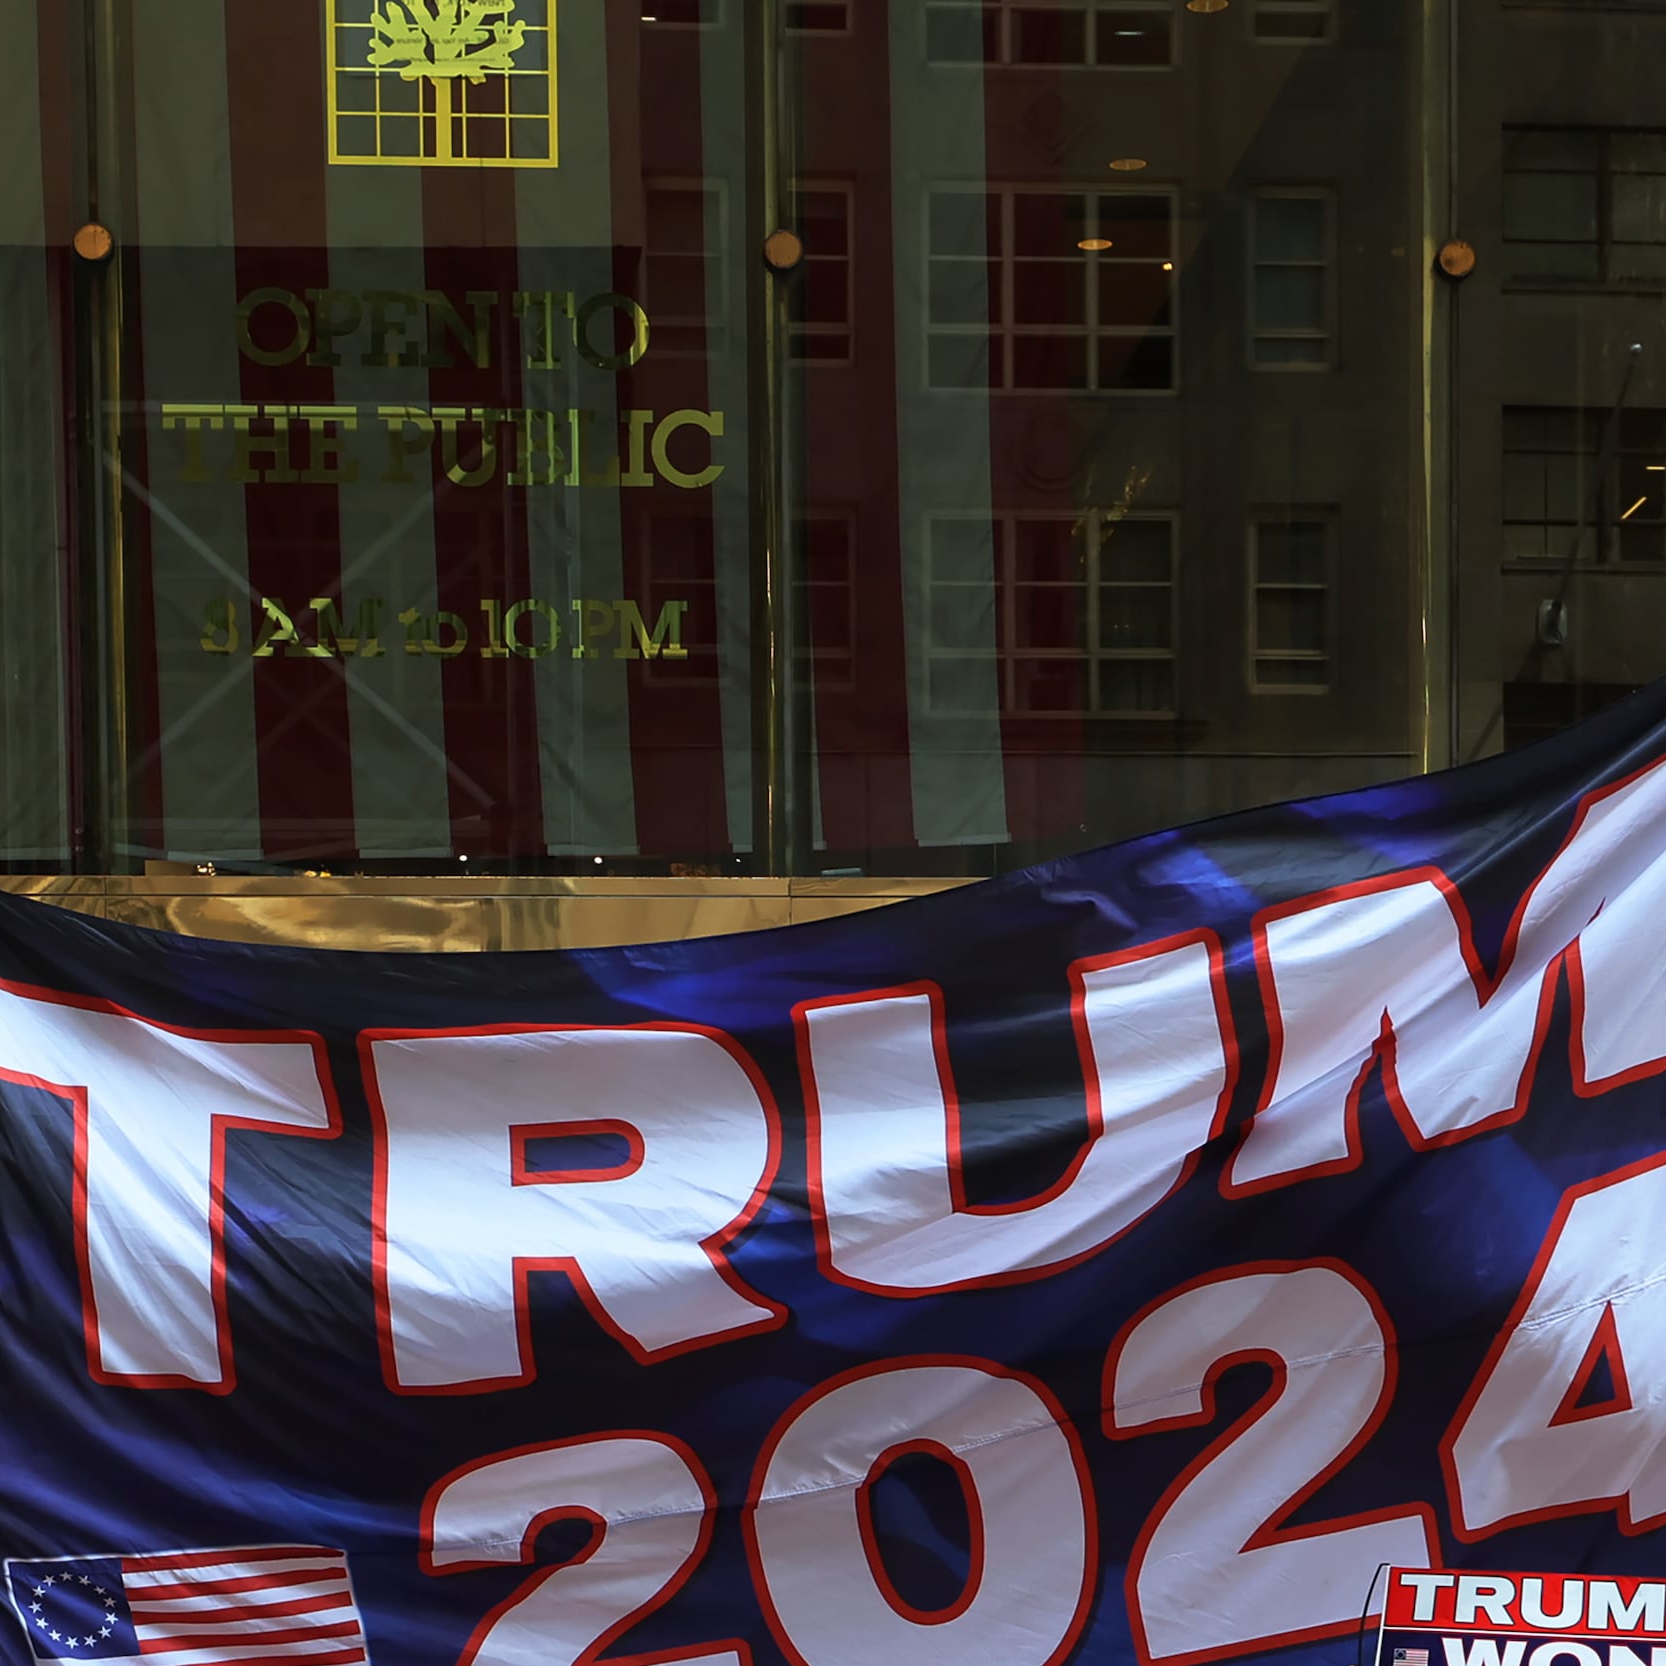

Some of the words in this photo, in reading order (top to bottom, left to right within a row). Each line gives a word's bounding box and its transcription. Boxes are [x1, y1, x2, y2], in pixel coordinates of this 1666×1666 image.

[236, 287, 499, 368] OPEN
[512, 291, 651, 371] TO
[161, 404, 358, 485] THE
[377, 404, 725, 489] PUBLIC
[252, 598, 385, 657] AM
[399, 608, 468, 656] to
[480, 599, 559, 658] 10
[572, 599, 690, 660] PM
